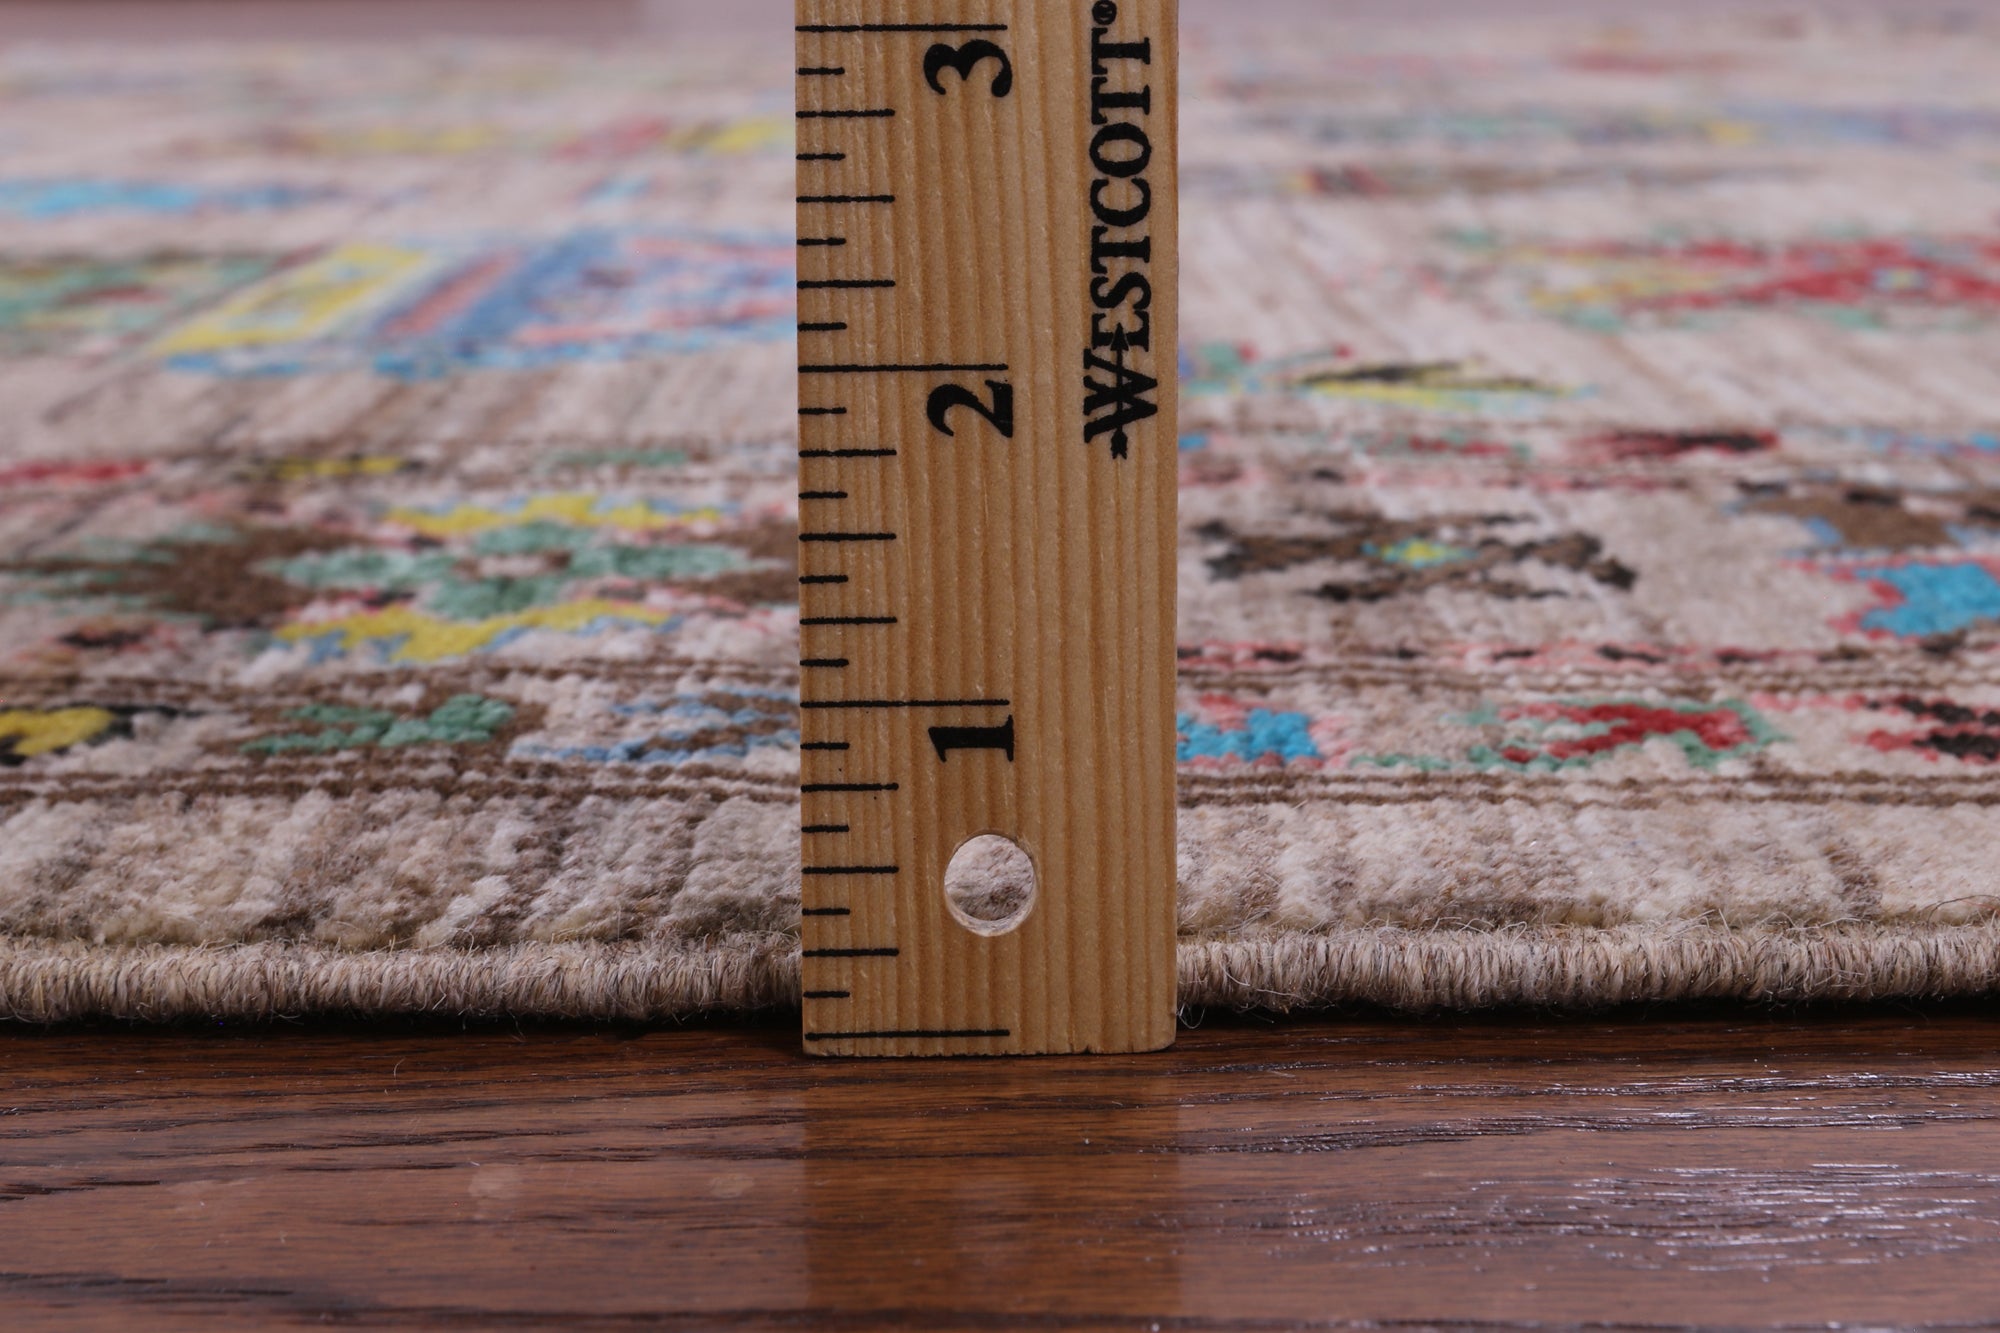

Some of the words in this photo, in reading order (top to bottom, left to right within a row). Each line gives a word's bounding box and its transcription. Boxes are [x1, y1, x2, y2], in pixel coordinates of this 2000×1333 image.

[922, 38, 1013, 98] 3
[1083, 27, 1158, 444] WESTCOTT
[925, 378, 1014, 438] 2
[928, 714, 1014, 762] 1
